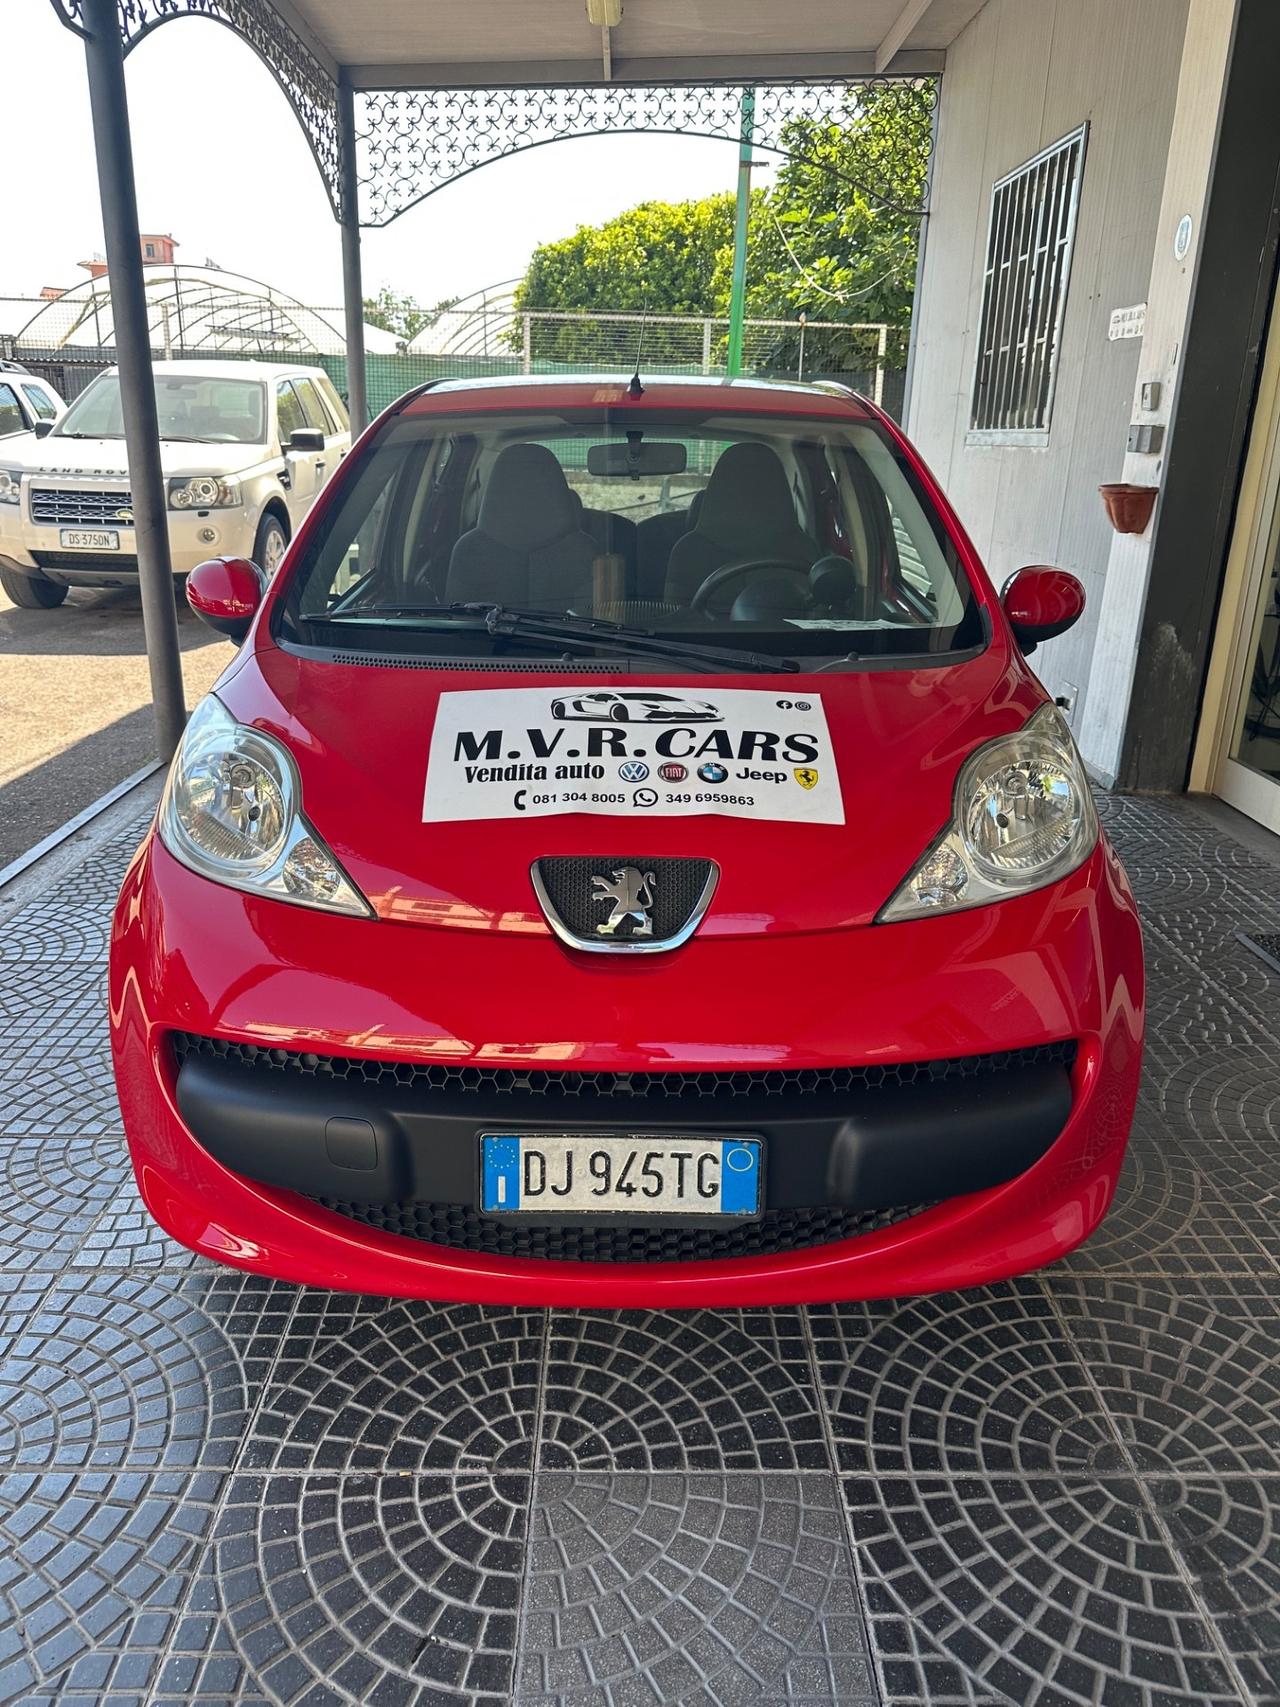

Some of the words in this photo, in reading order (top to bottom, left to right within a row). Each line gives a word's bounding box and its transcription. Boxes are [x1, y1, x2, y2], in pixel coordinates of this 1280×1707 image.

[39, 466, 83, 474] LAND
[465, 764, 548, 784] Vendita
[555, 763, 605, 780] auto
[665, 767, 683, 777] FIAT
[735, 767, 788, 784] Jeep
[533, 794, 557, 804] 081
[562, 792, 588, 802] 304
[591, 793, 626, 803] 8005
[665, 794, 692, 804] 349
[695, 794, 755, 806] 6959863
